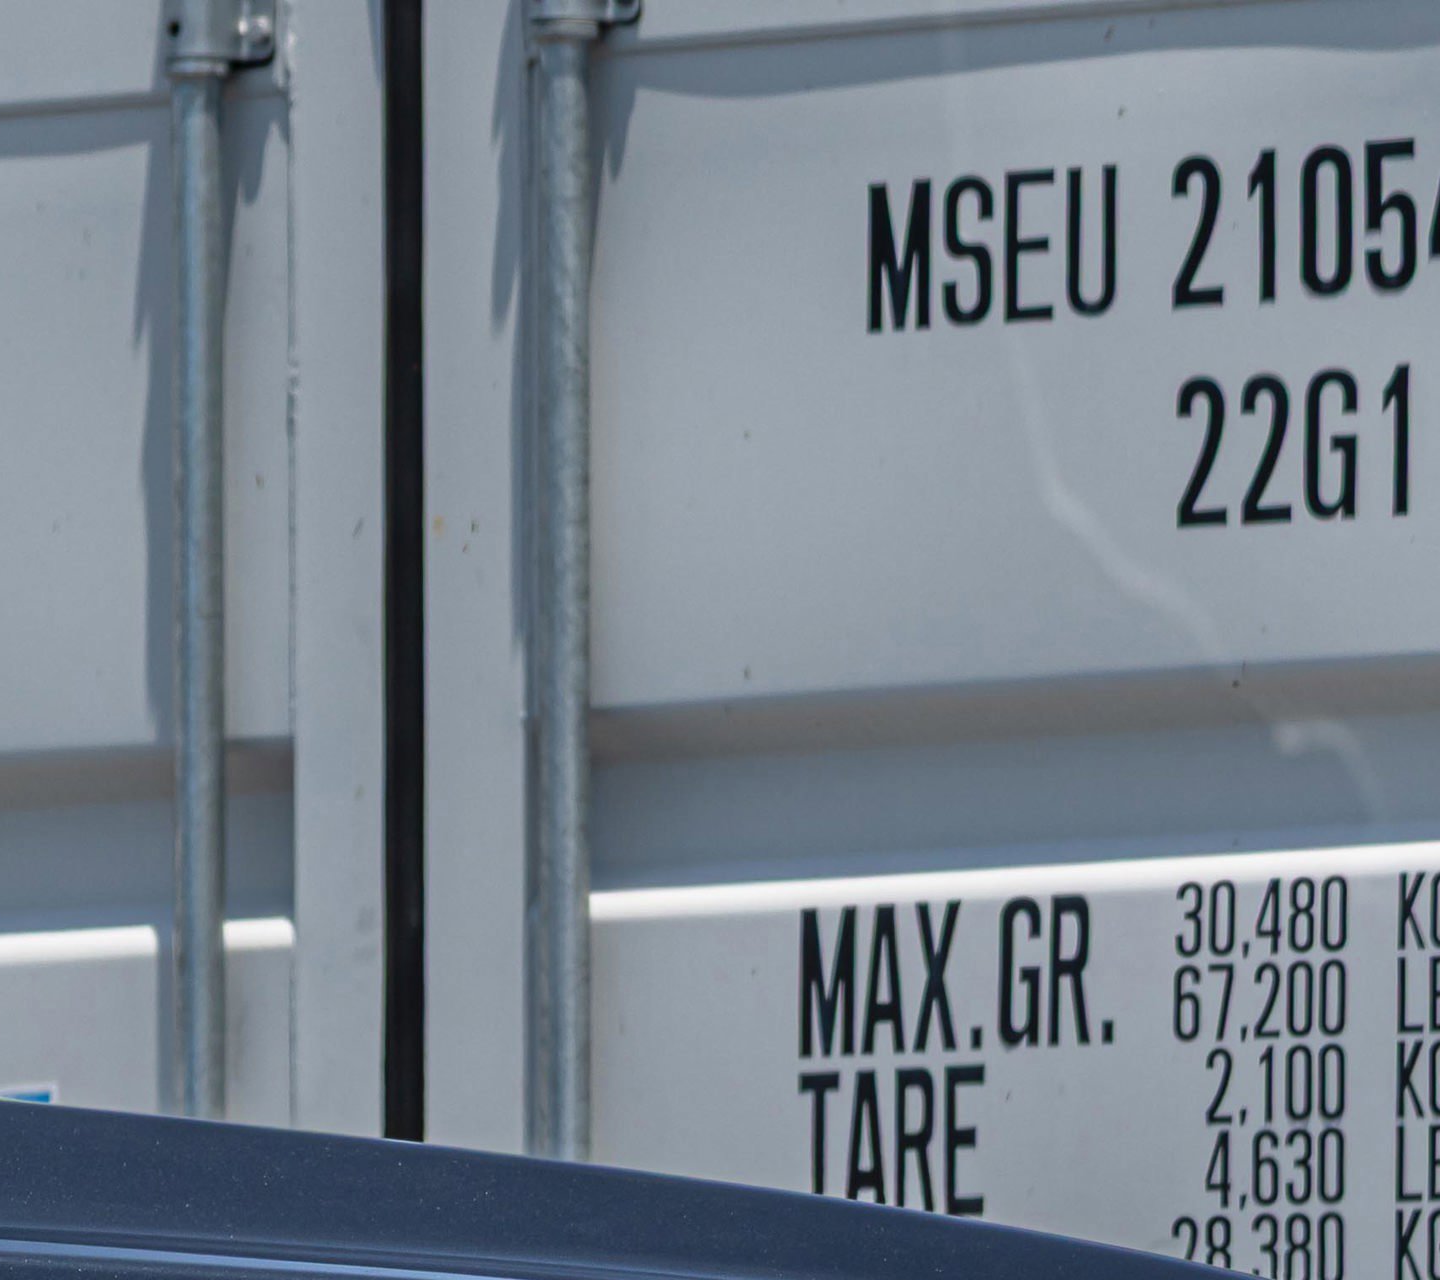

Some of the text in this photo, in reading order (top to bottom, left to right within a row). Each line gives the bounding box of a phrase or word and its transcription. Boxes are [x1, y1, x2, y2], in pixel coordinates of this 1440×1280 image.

[868, 165, 1118, 333] MSEU
[1177, 364, 1411, 526] 22G1
[1176, 876, 1348, 958] 30,480
[1173, 960, 1346, 1043] 67,200
[799, 1064, 985, 1213] TARE
[1205, 1043, 1346, 1126] 2,100
[1205, 1128, 1344, 1211] 4,630
